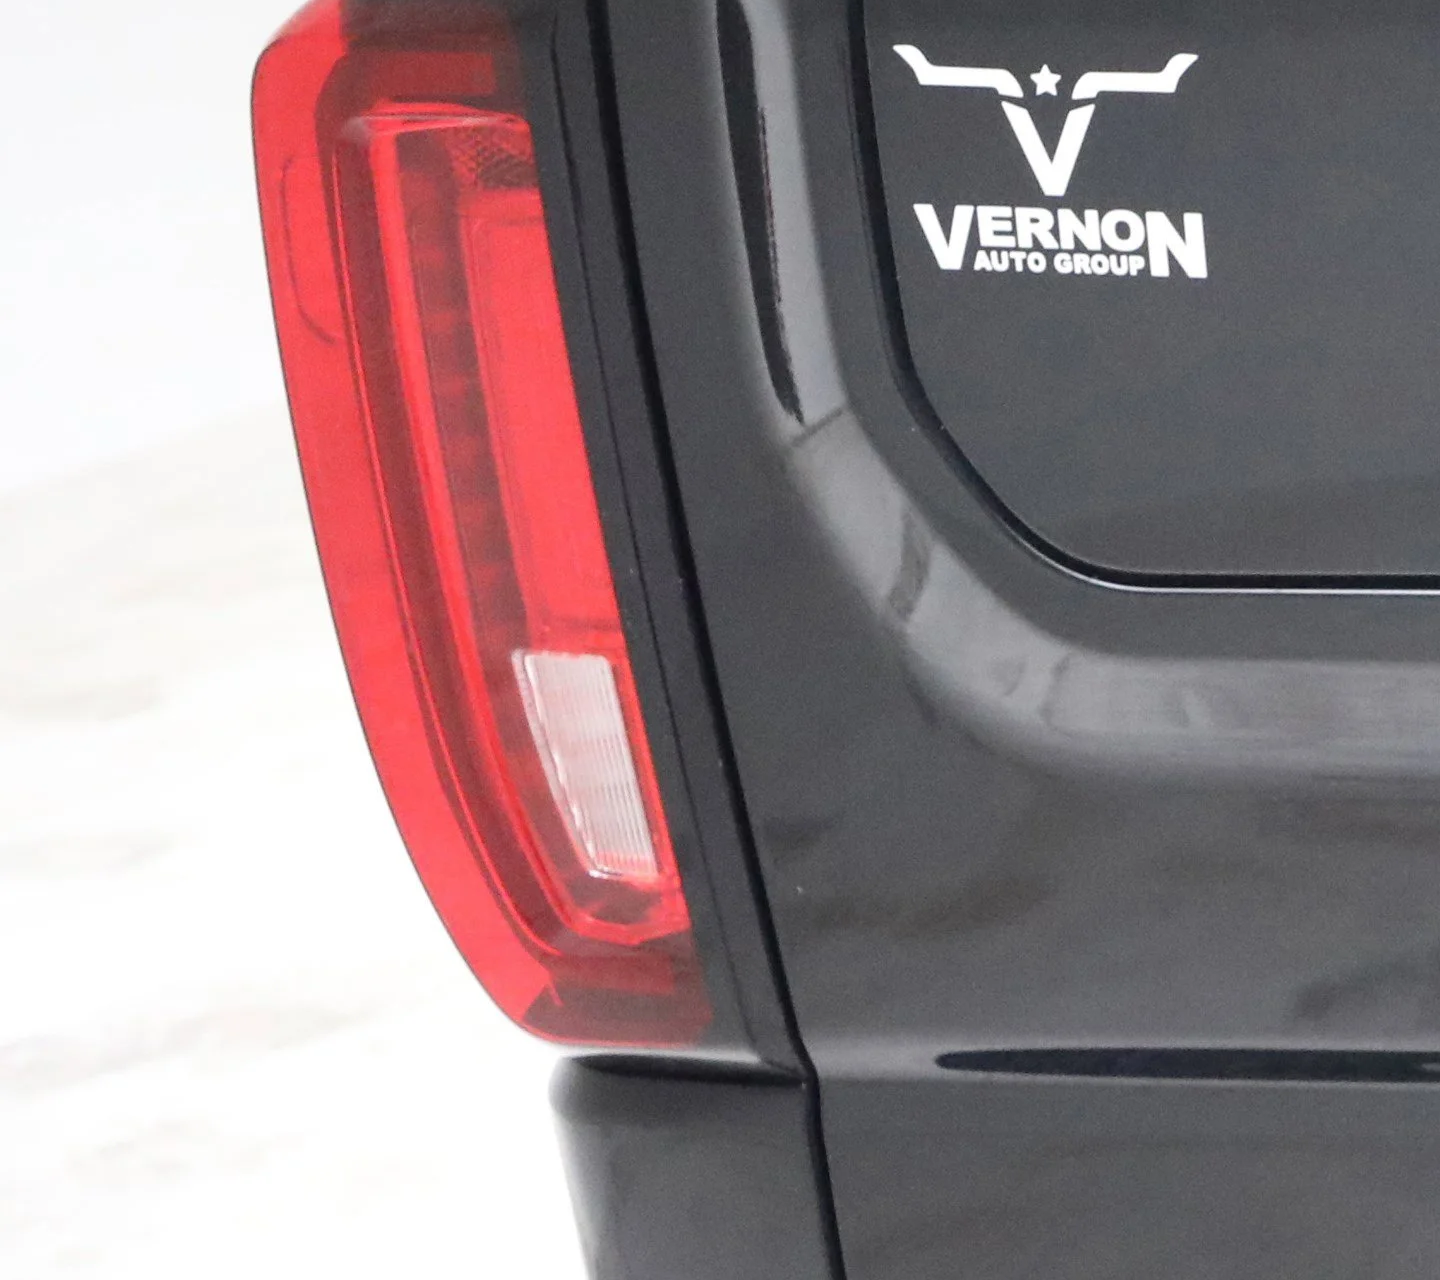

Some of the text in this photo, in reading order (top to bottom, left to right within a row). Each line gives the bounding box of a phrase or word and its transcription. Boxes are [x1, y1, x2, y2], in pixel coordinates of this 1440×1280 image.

[913, 203, 1208, 279] VERNON
[974, 250, 1145, 277] AUTO GROUP
